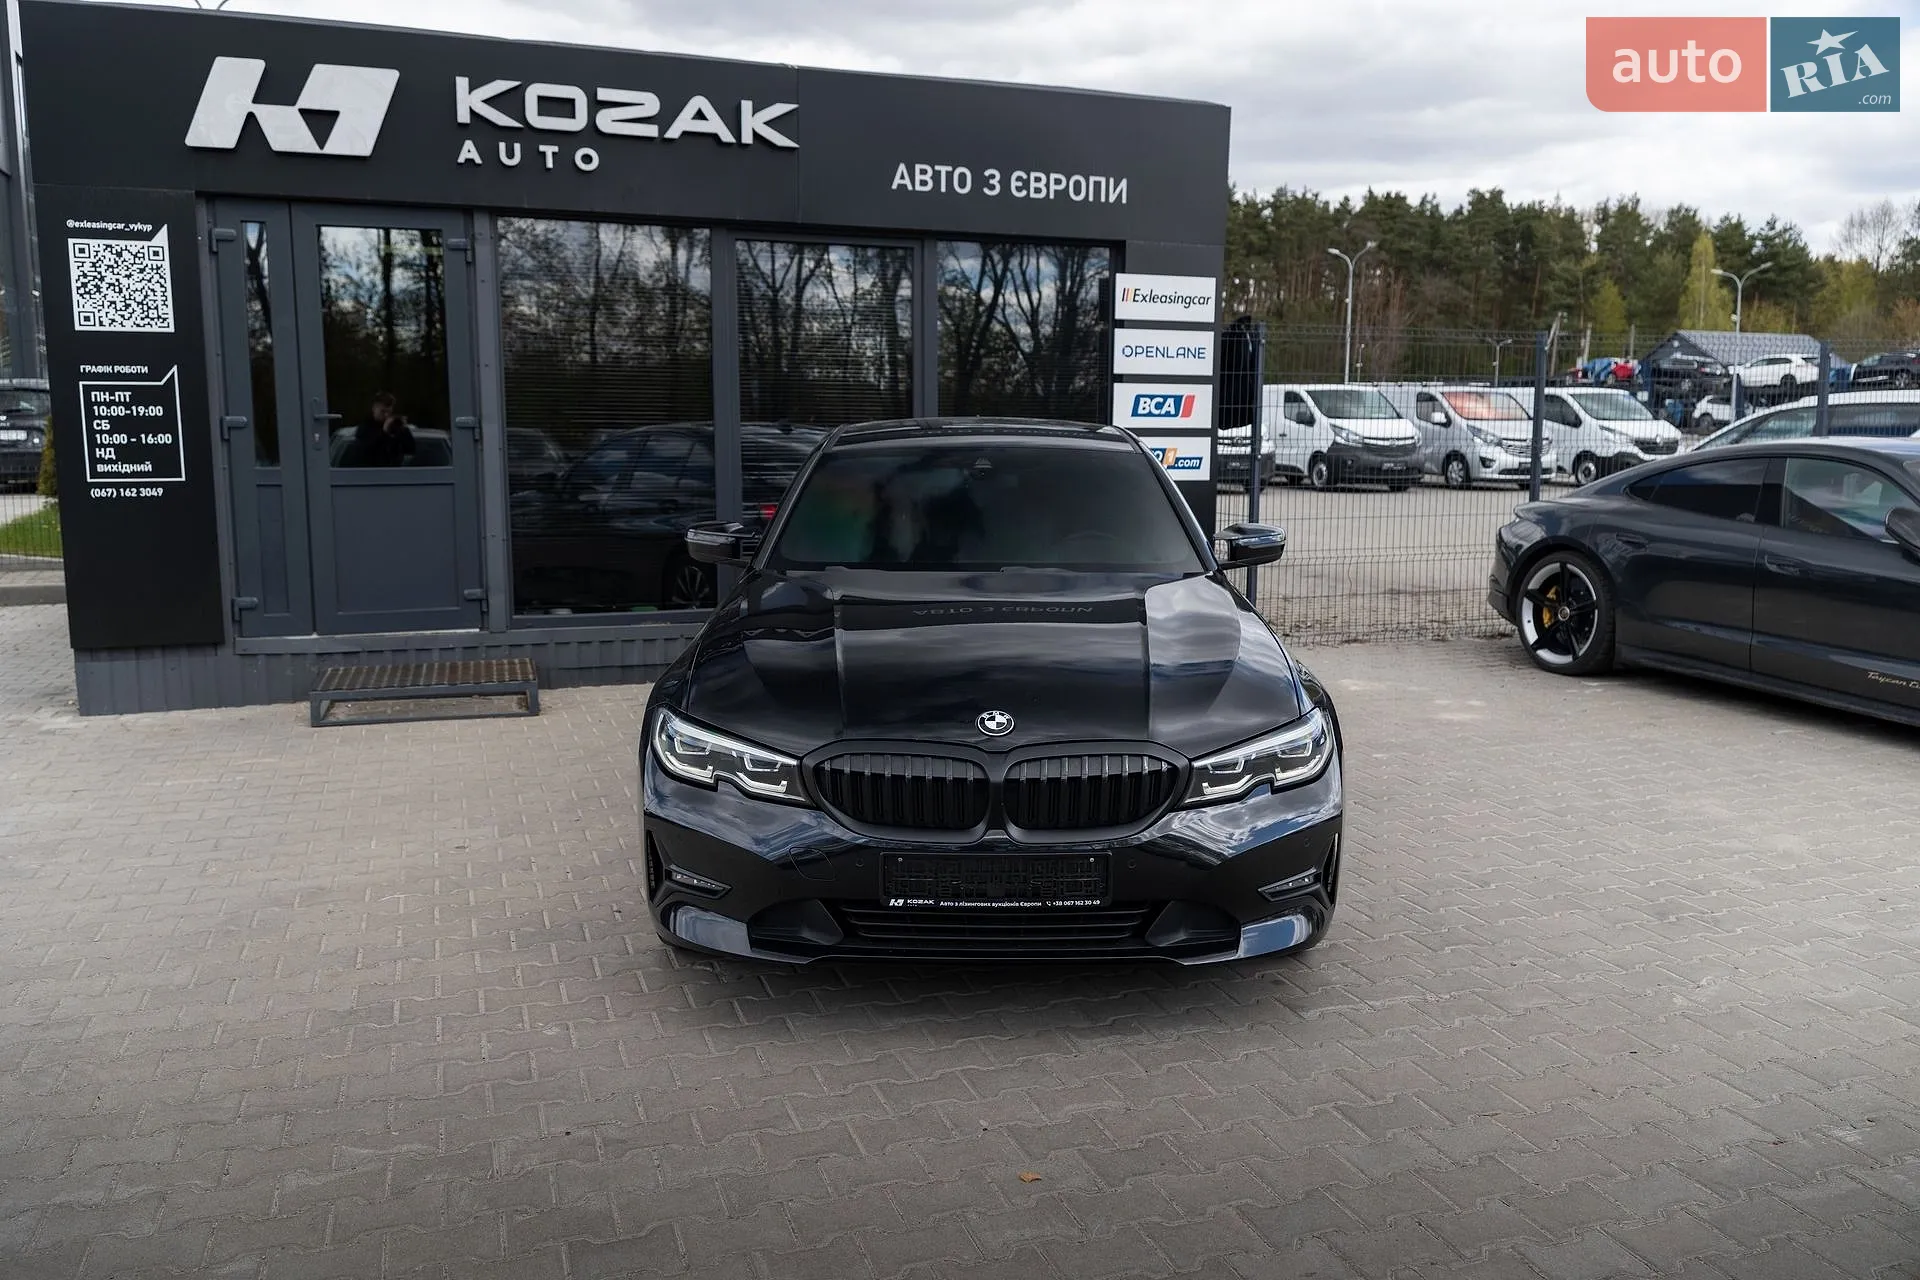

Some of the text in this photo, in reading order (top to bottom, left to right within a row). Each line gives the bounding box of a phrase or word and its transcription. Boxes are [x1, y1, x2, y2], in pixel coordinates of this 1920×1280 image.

[455, 76, 801, 149] KOZAK
[456, 139, 600, 172] AUTO
[891, 162, 1129, 204] АВТО З ЄВРОПИ
[66, 219, 153, 232] @exleasingcar_vykyp
[1132, 287, 1212, 309] Exleasingcar
[1121, 345, 1207, 360] OPENLANE
[80, 364, 149, 374] ГРАФІК РОБОТИ
[90, 391, 132, 403] ПН-ПТ
[92, 405, 164, 417] 10:00-19:00
[1137, 396, 1177, 416] BCA
[92, 419, 111, 430] СБ
[95, 433, 128, 445] 10:00
[140, 433, 173, 445] 16:00
[95, 447, 116, 460] НД
[96, 461, 153, 474] вихідний
[90, 487, 164, 498] (067) 162 3049
